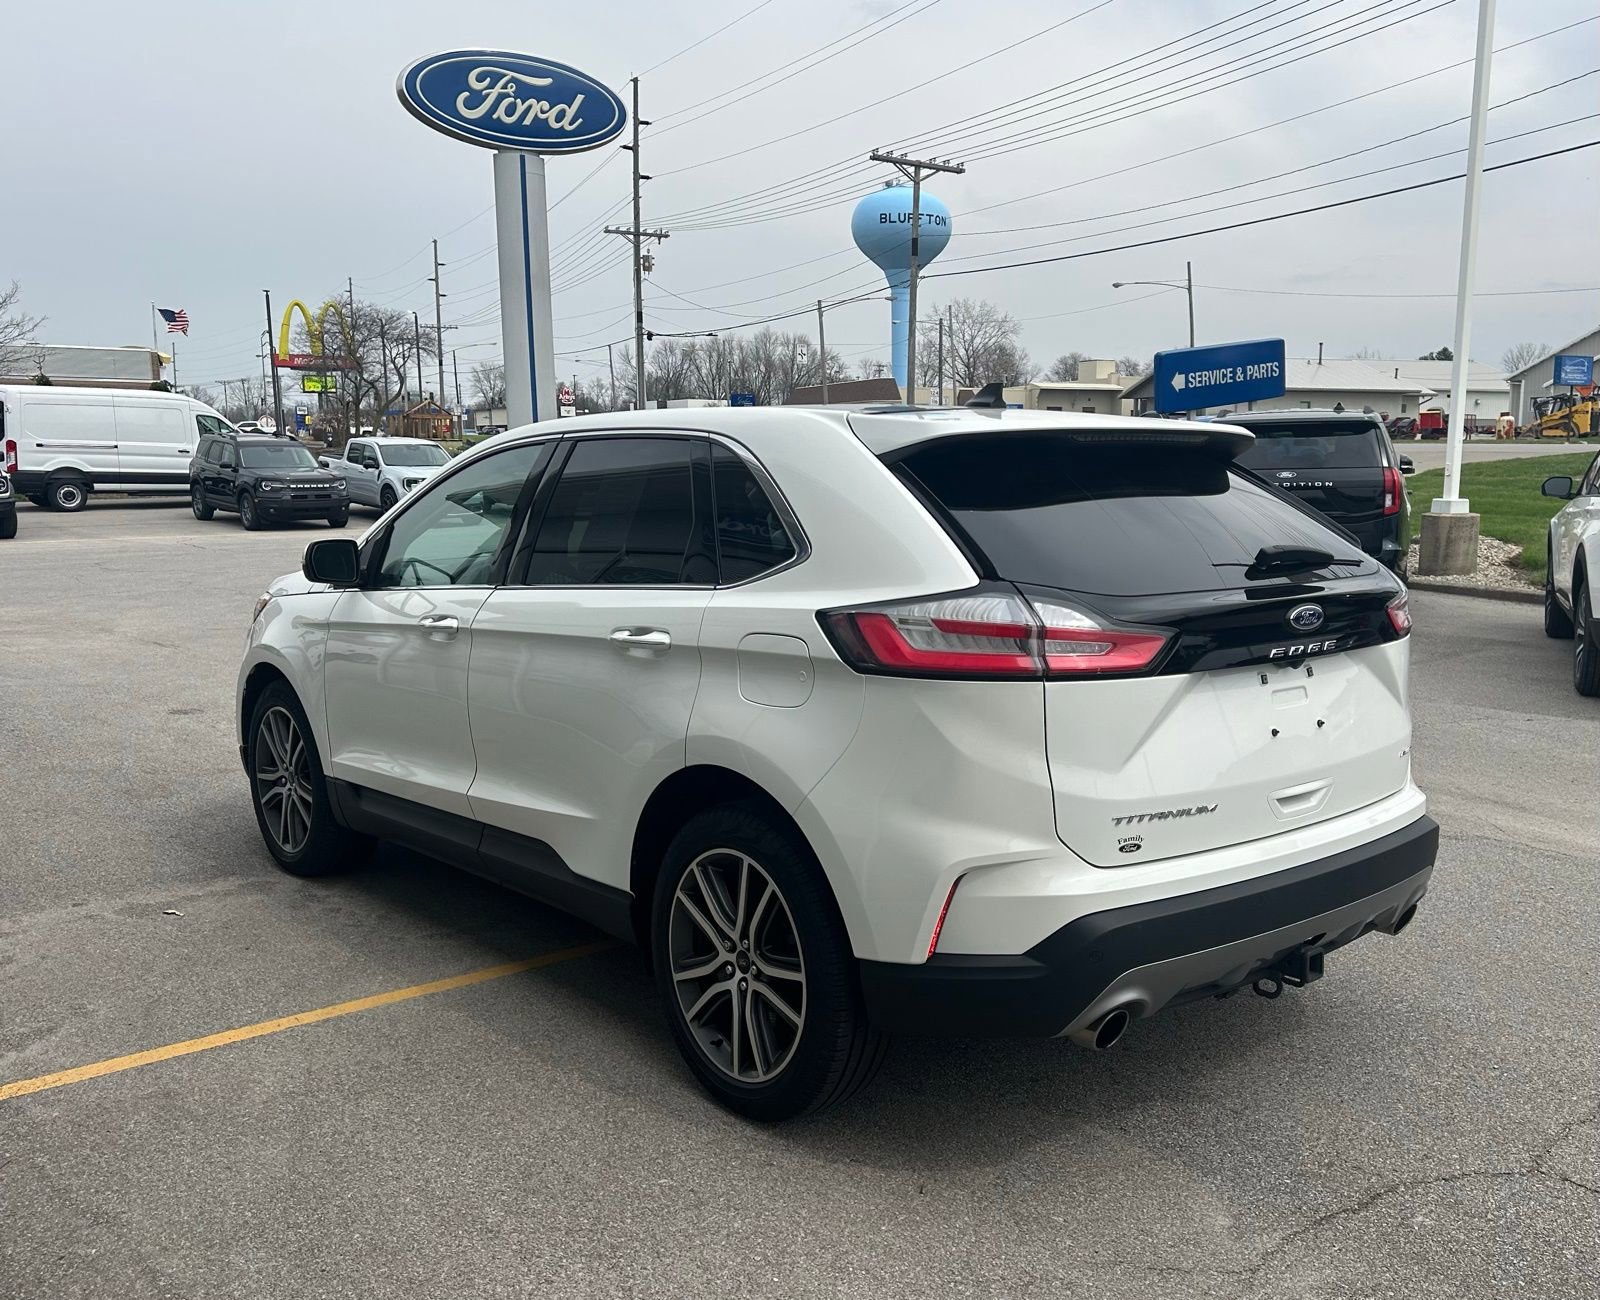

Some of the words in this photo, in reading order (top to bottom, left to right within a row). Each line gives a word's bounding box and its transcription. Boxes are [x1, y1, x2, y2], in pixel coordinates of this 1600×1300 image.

[456, 66, 586, 131] Ford
[1188, 367, 1233, 388] SERVICE
[1236, 366, 1245, 382] &
[1246, 361, 1280, 380] PARTS
[1269, 640, 1337, 659] EDGE
[1111, 803, 1219, 827] TITANIUM
[1117, 834, 1144, 845] Family
